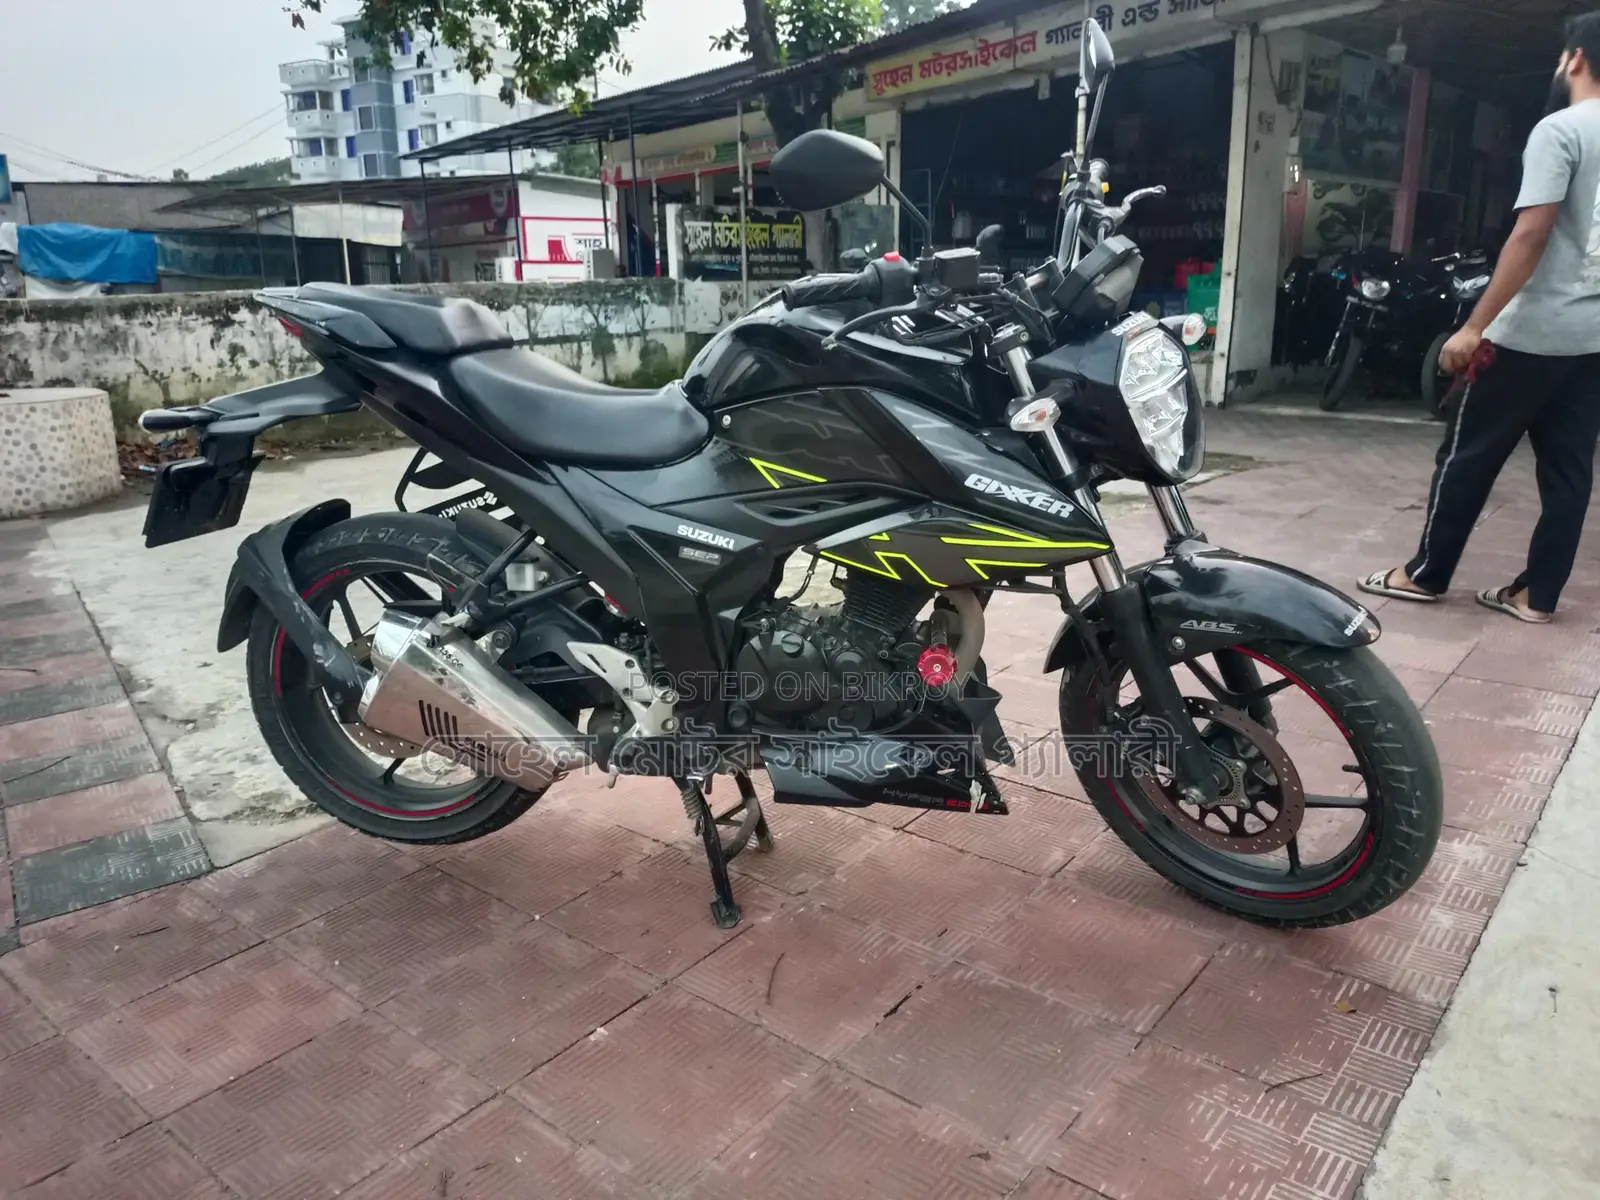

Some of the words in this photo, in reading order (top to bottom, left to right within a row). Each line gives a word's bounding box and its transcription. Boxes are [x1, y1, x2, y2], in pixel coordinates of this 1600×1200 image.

[964, 473, 1075, 518] GIXXER
[677, 524, 735, 551] SUZUKI
[1180, 619, 1239, 634] ABS
